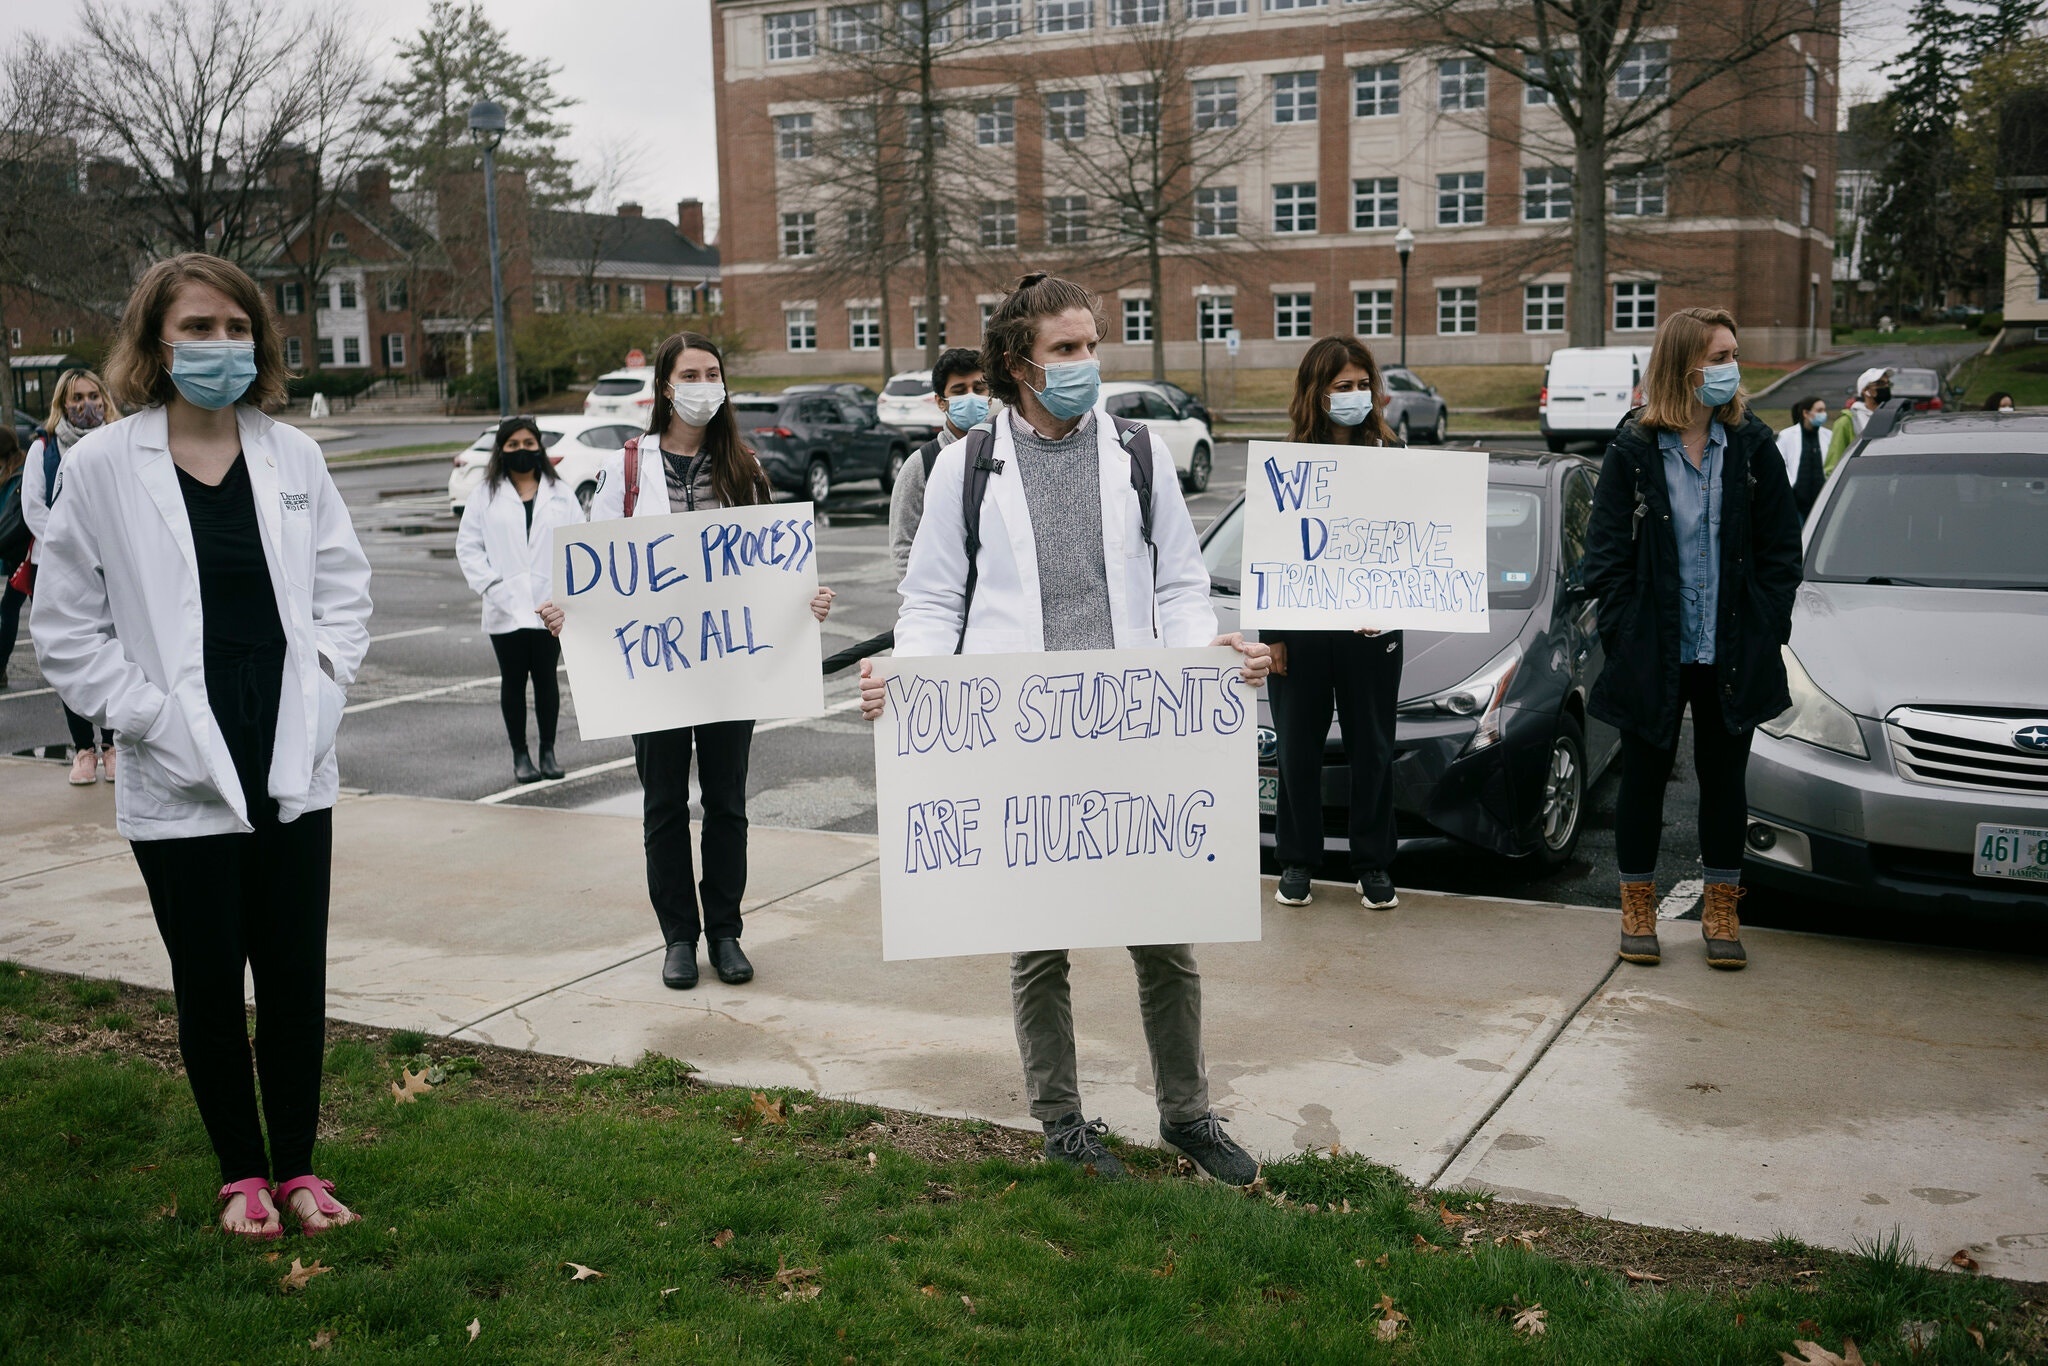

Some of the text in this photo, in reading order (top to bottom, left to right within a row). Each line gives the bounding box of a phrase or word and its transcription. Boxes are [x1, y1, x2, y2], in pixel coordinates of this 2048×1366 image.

[1264, 457, 1337, 512] WE
[565, 519, 814, 596] DUE PROCESS
[1301, 517, 1453, 568] DESERVE
[1250, 562, 1486, 613] TRANSPARENCY.
[613, 606, 773, 680] FOR ALL
[885, 667, 1245, 756] YOUR STUDENTS
[905, 789, 1216, 873] ARE HURTING.
[1981, 834, 2019, 863] 461
